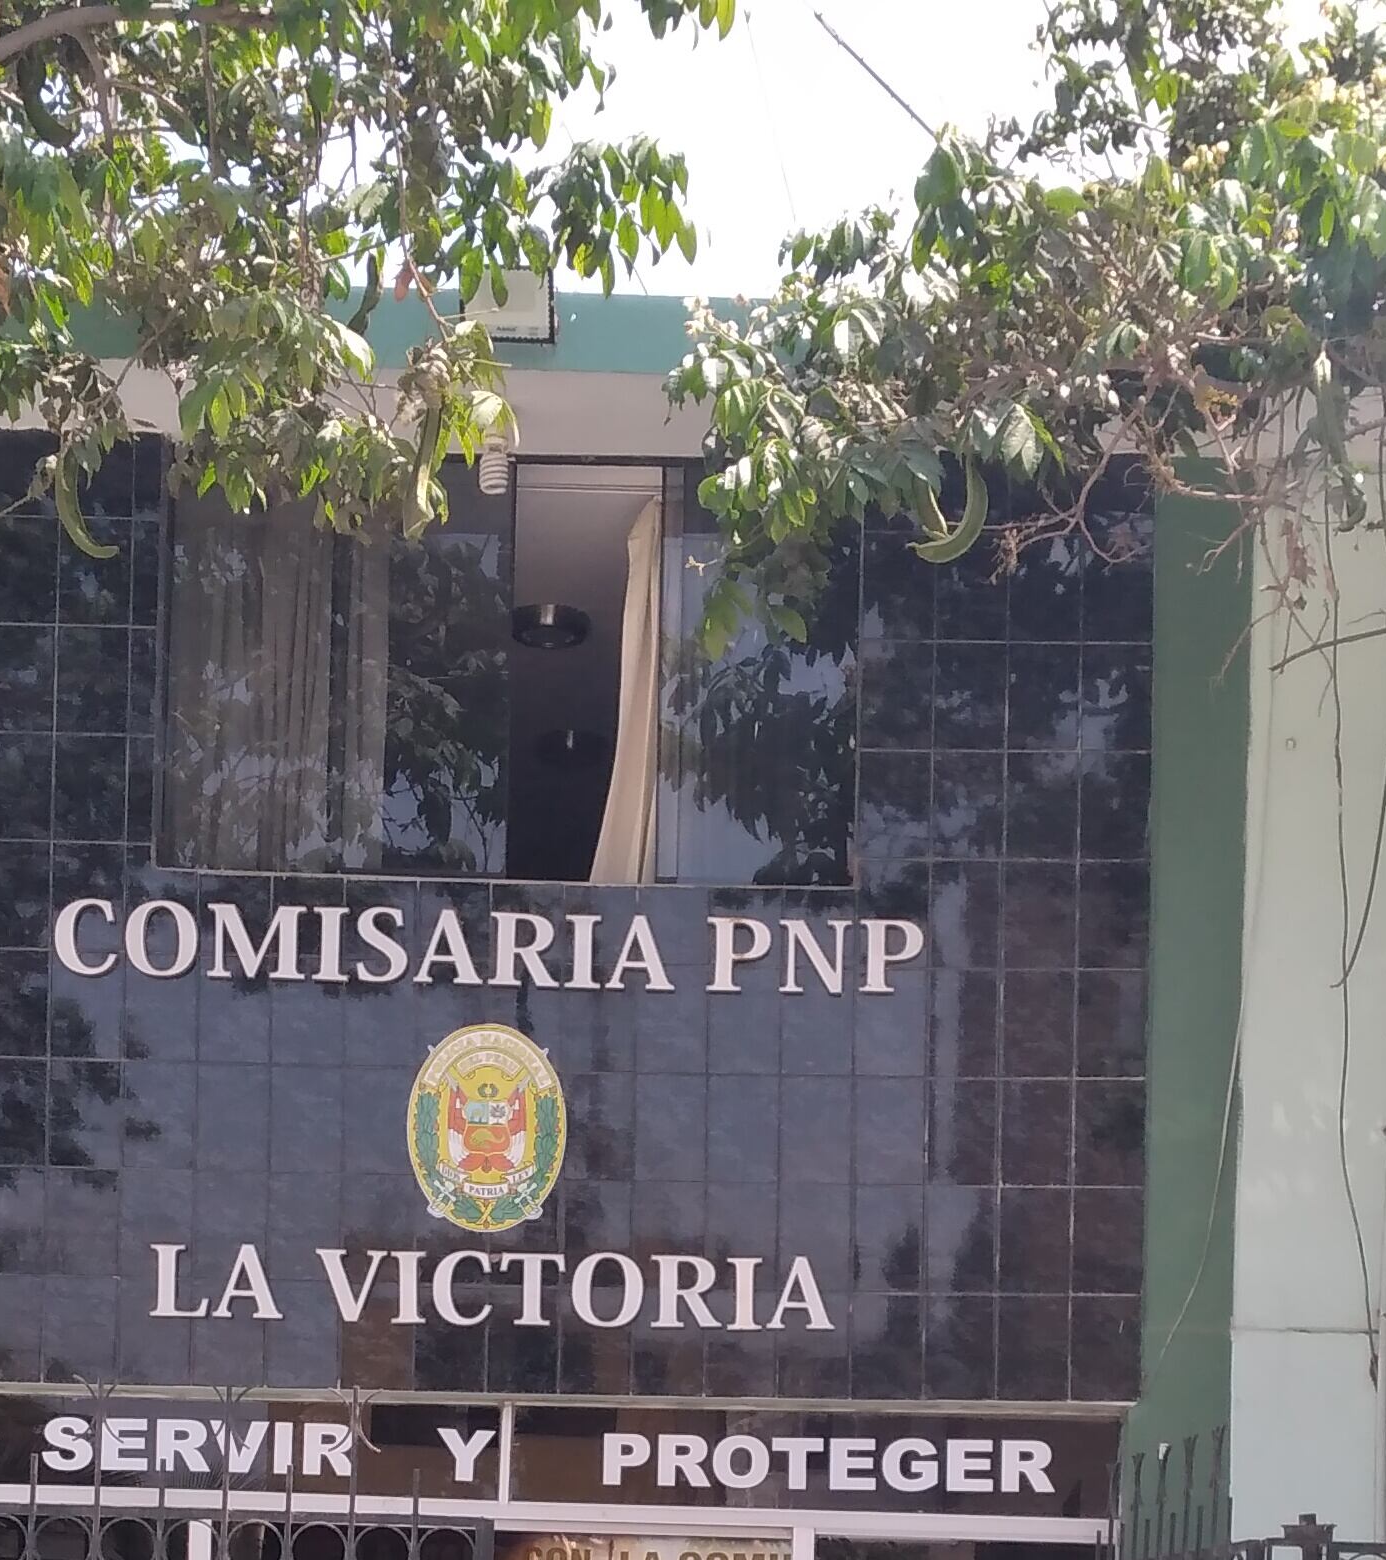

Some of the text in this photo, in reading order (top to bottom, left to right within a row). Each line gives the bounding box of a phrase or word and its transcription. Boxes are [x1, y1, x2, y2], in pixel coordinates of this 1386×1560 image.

[54, 897, 925, 995] COMISARIA PNP
[468, 1185, 505, 1196] PATRIA
[149, 1242, 836, 1331] LA VICTORIA
[41, 1416, 1056, 1493] SERVIR Y PROTEGER
